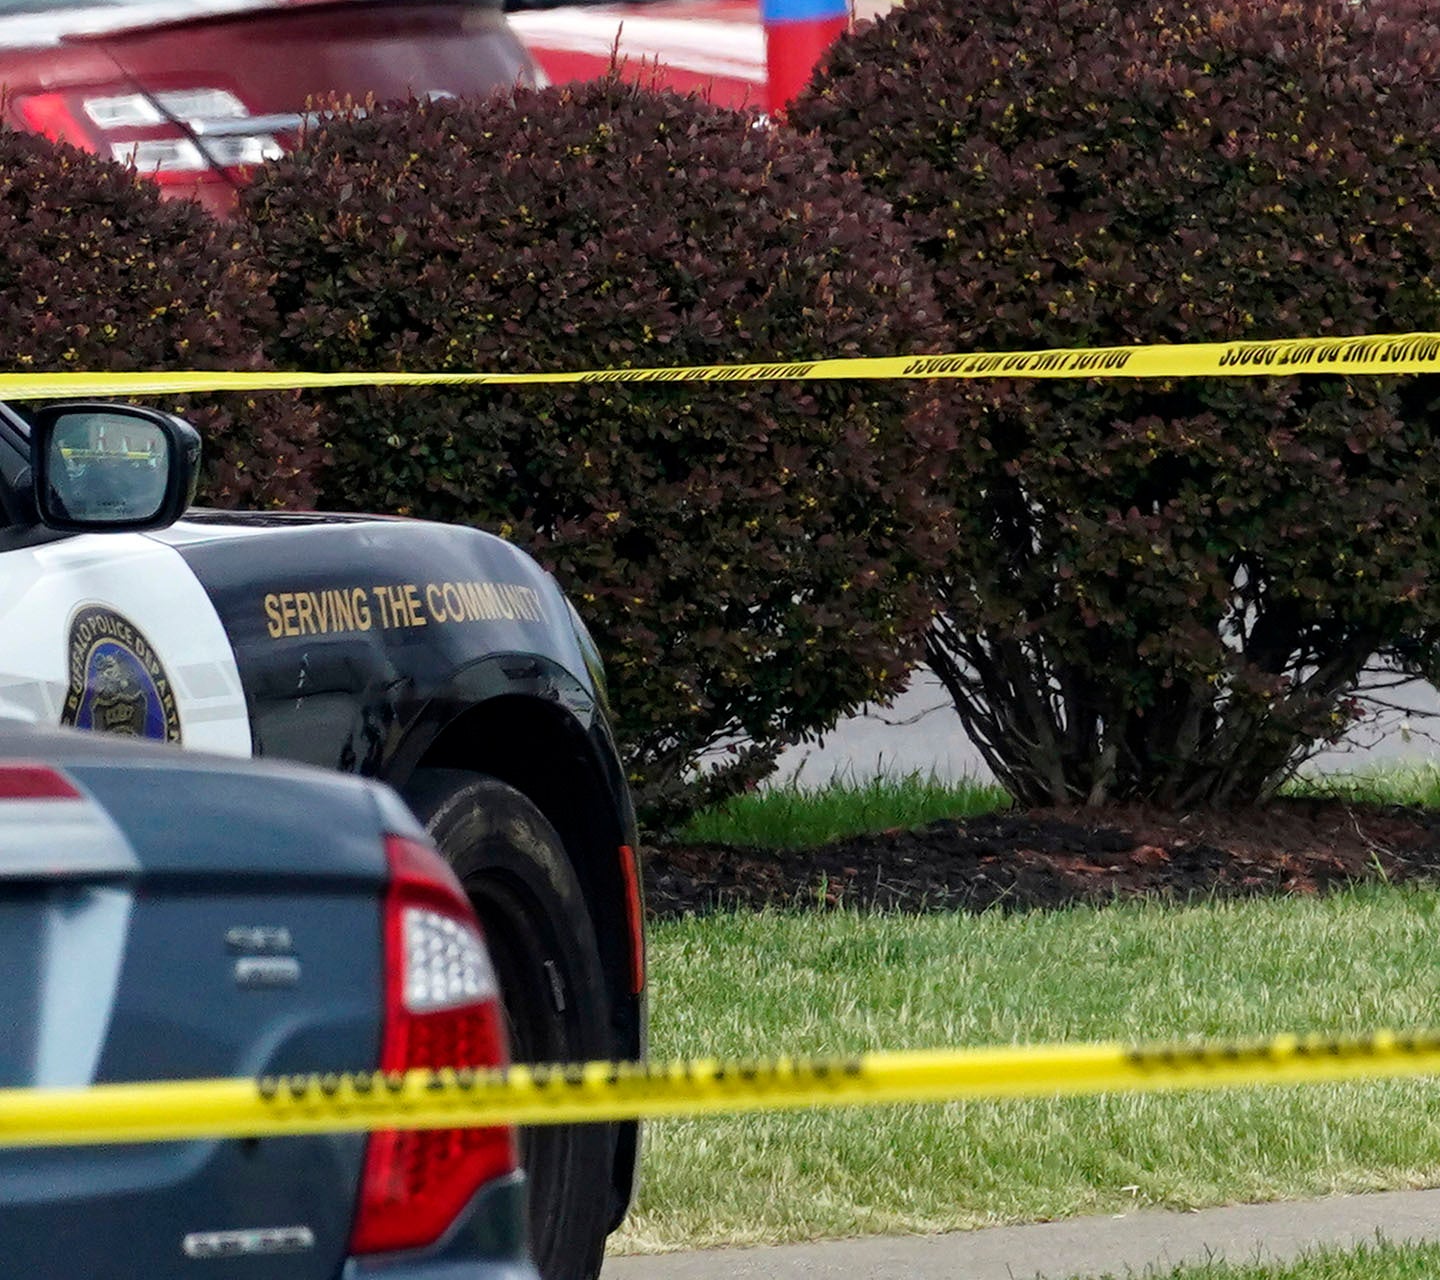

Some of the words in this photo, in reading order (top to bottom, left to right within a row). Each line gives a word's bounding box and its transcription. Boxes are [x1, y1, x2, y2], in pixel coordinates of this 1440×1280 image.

[87, 614, 133, 645] POLICE
[264, 587, 371, 639] SERVING
[373, 584, 427, 628] THE
[425, 582, 549, 626] COMMUNITY
